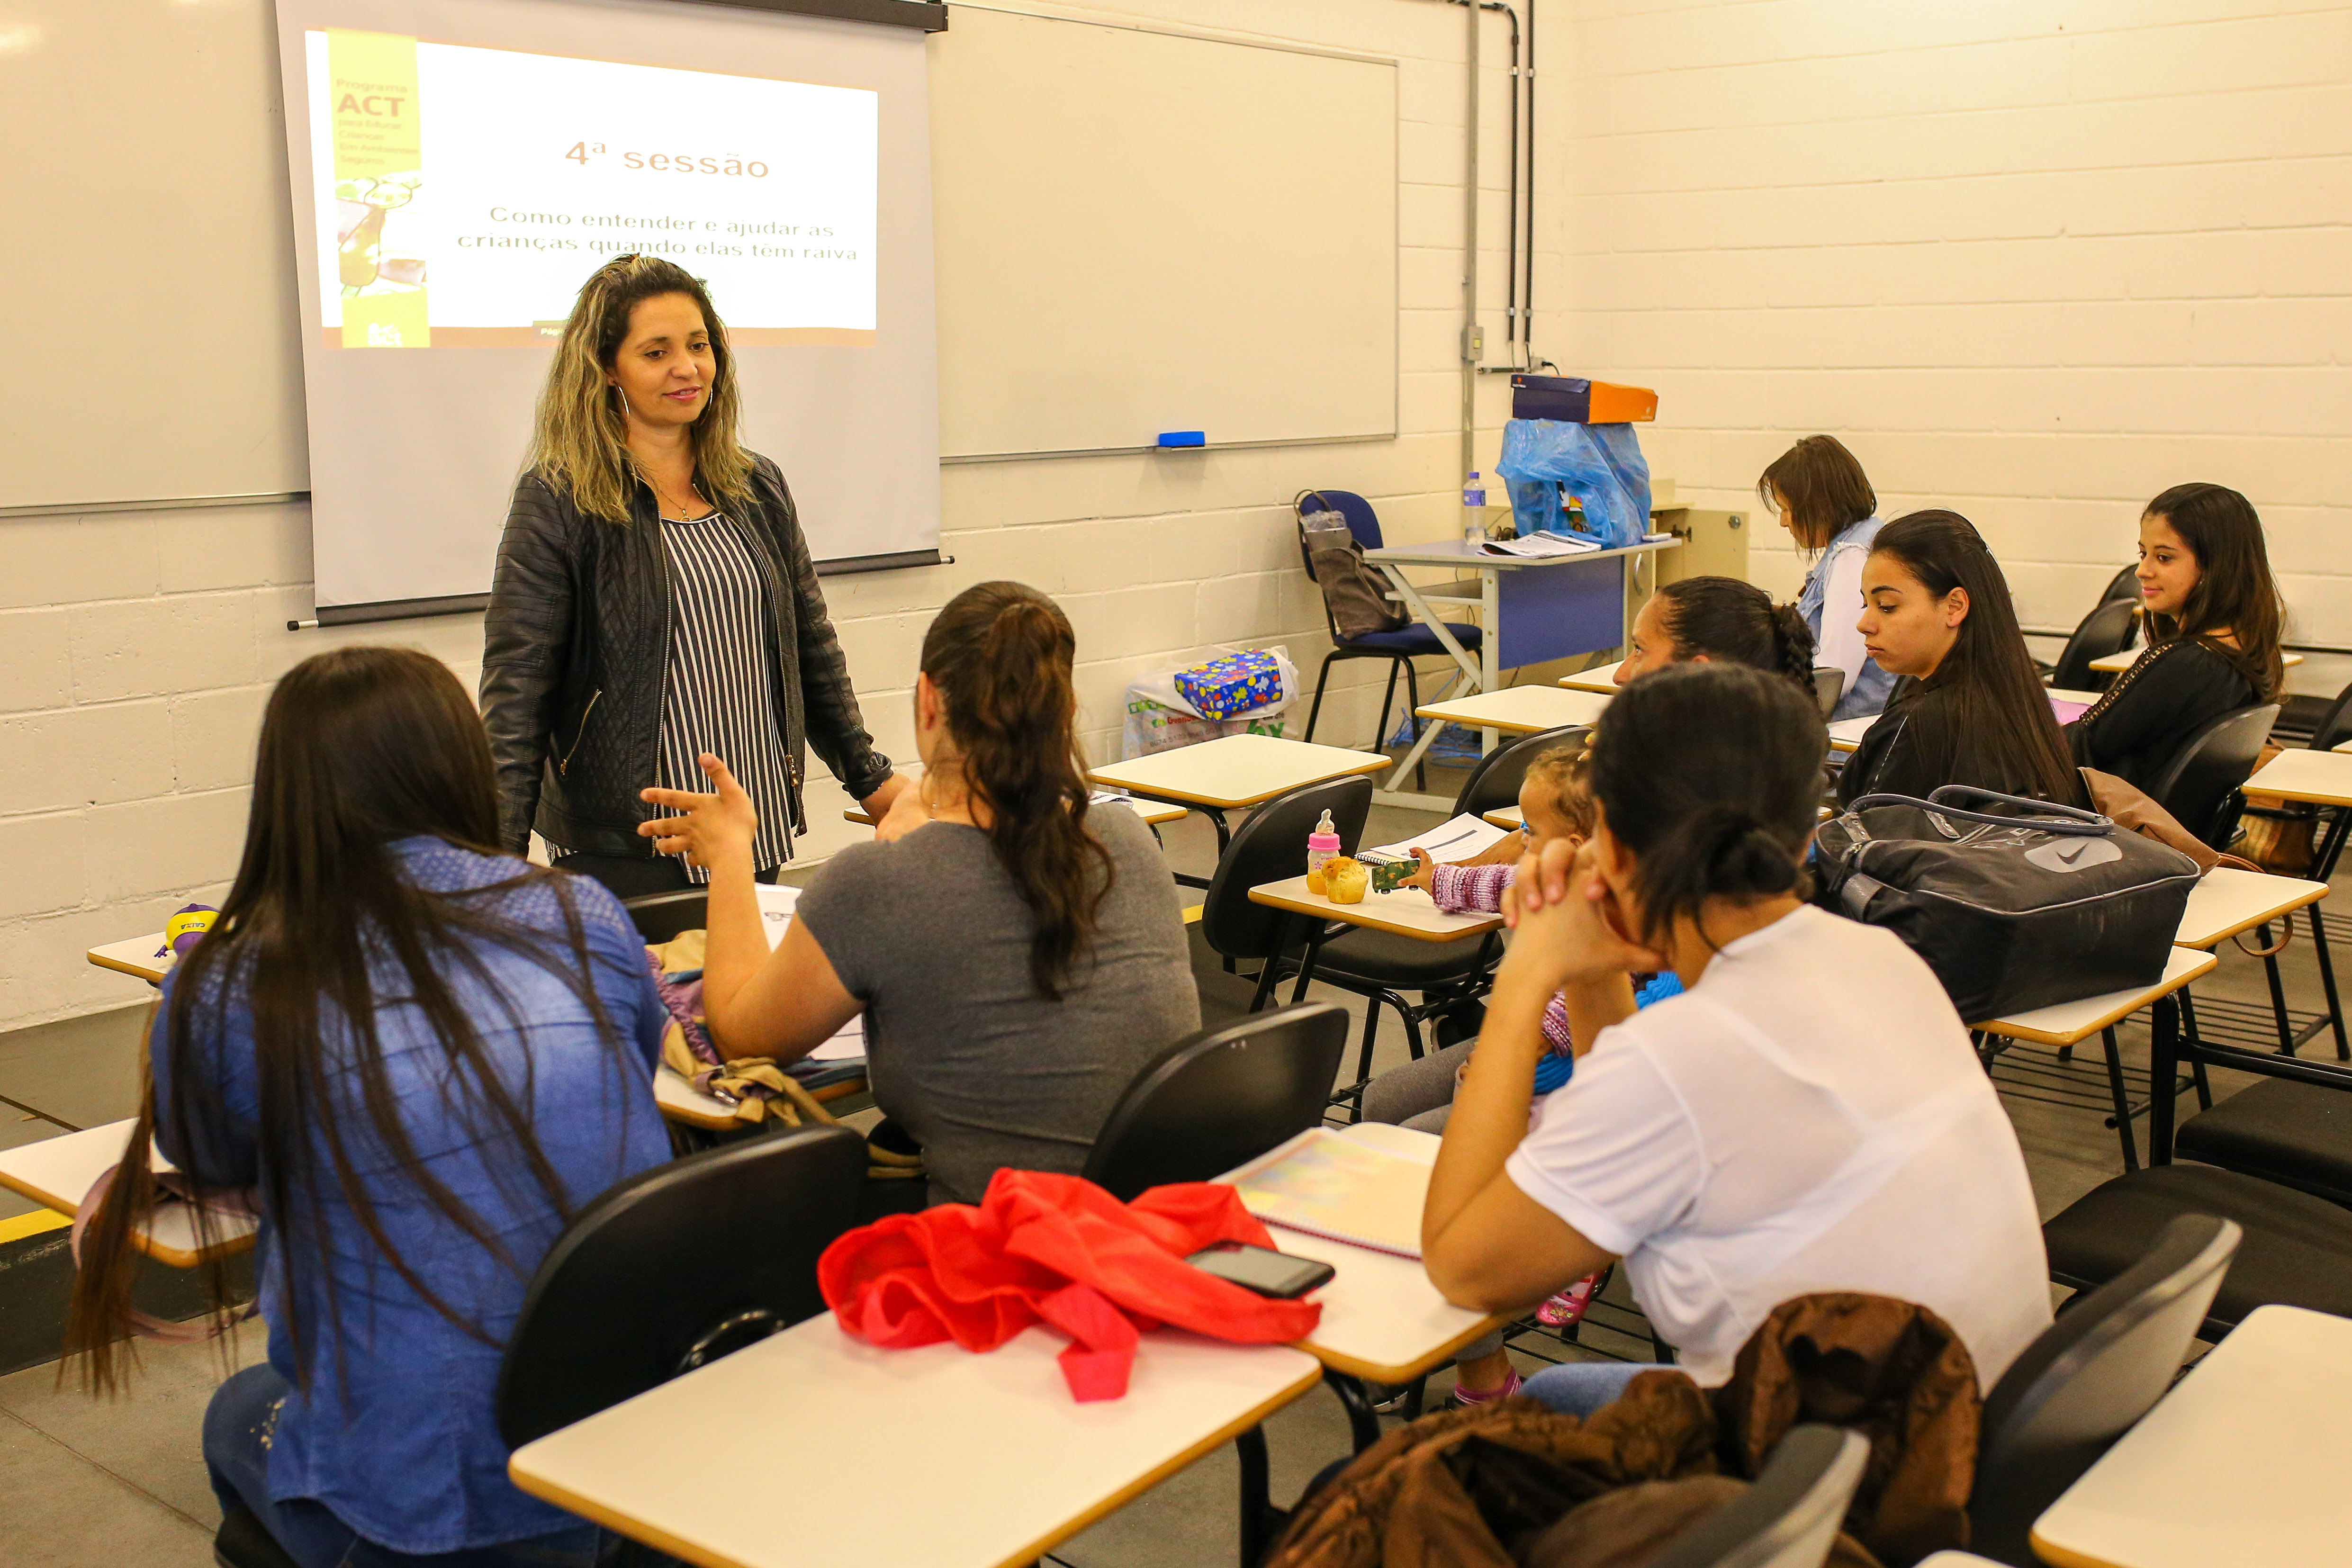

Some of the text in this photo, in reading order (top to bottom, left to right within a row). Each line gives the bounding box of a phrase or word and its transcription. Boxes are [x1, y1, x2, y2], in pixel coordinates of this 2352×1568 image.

[336, 78, 407, 93] Programa
[337, 93, 405, 117] ACT
[365, 120, 402, 129] Educar
[360, 144, 418, 155] Ambientes
[623, 153, 769, 178] sessão
[490, 207, 834, 237] Como entender e ajudar as
[458, 233, 857, 260] crianças quando elas têm raiva
[367, 332, 403, 346] act
